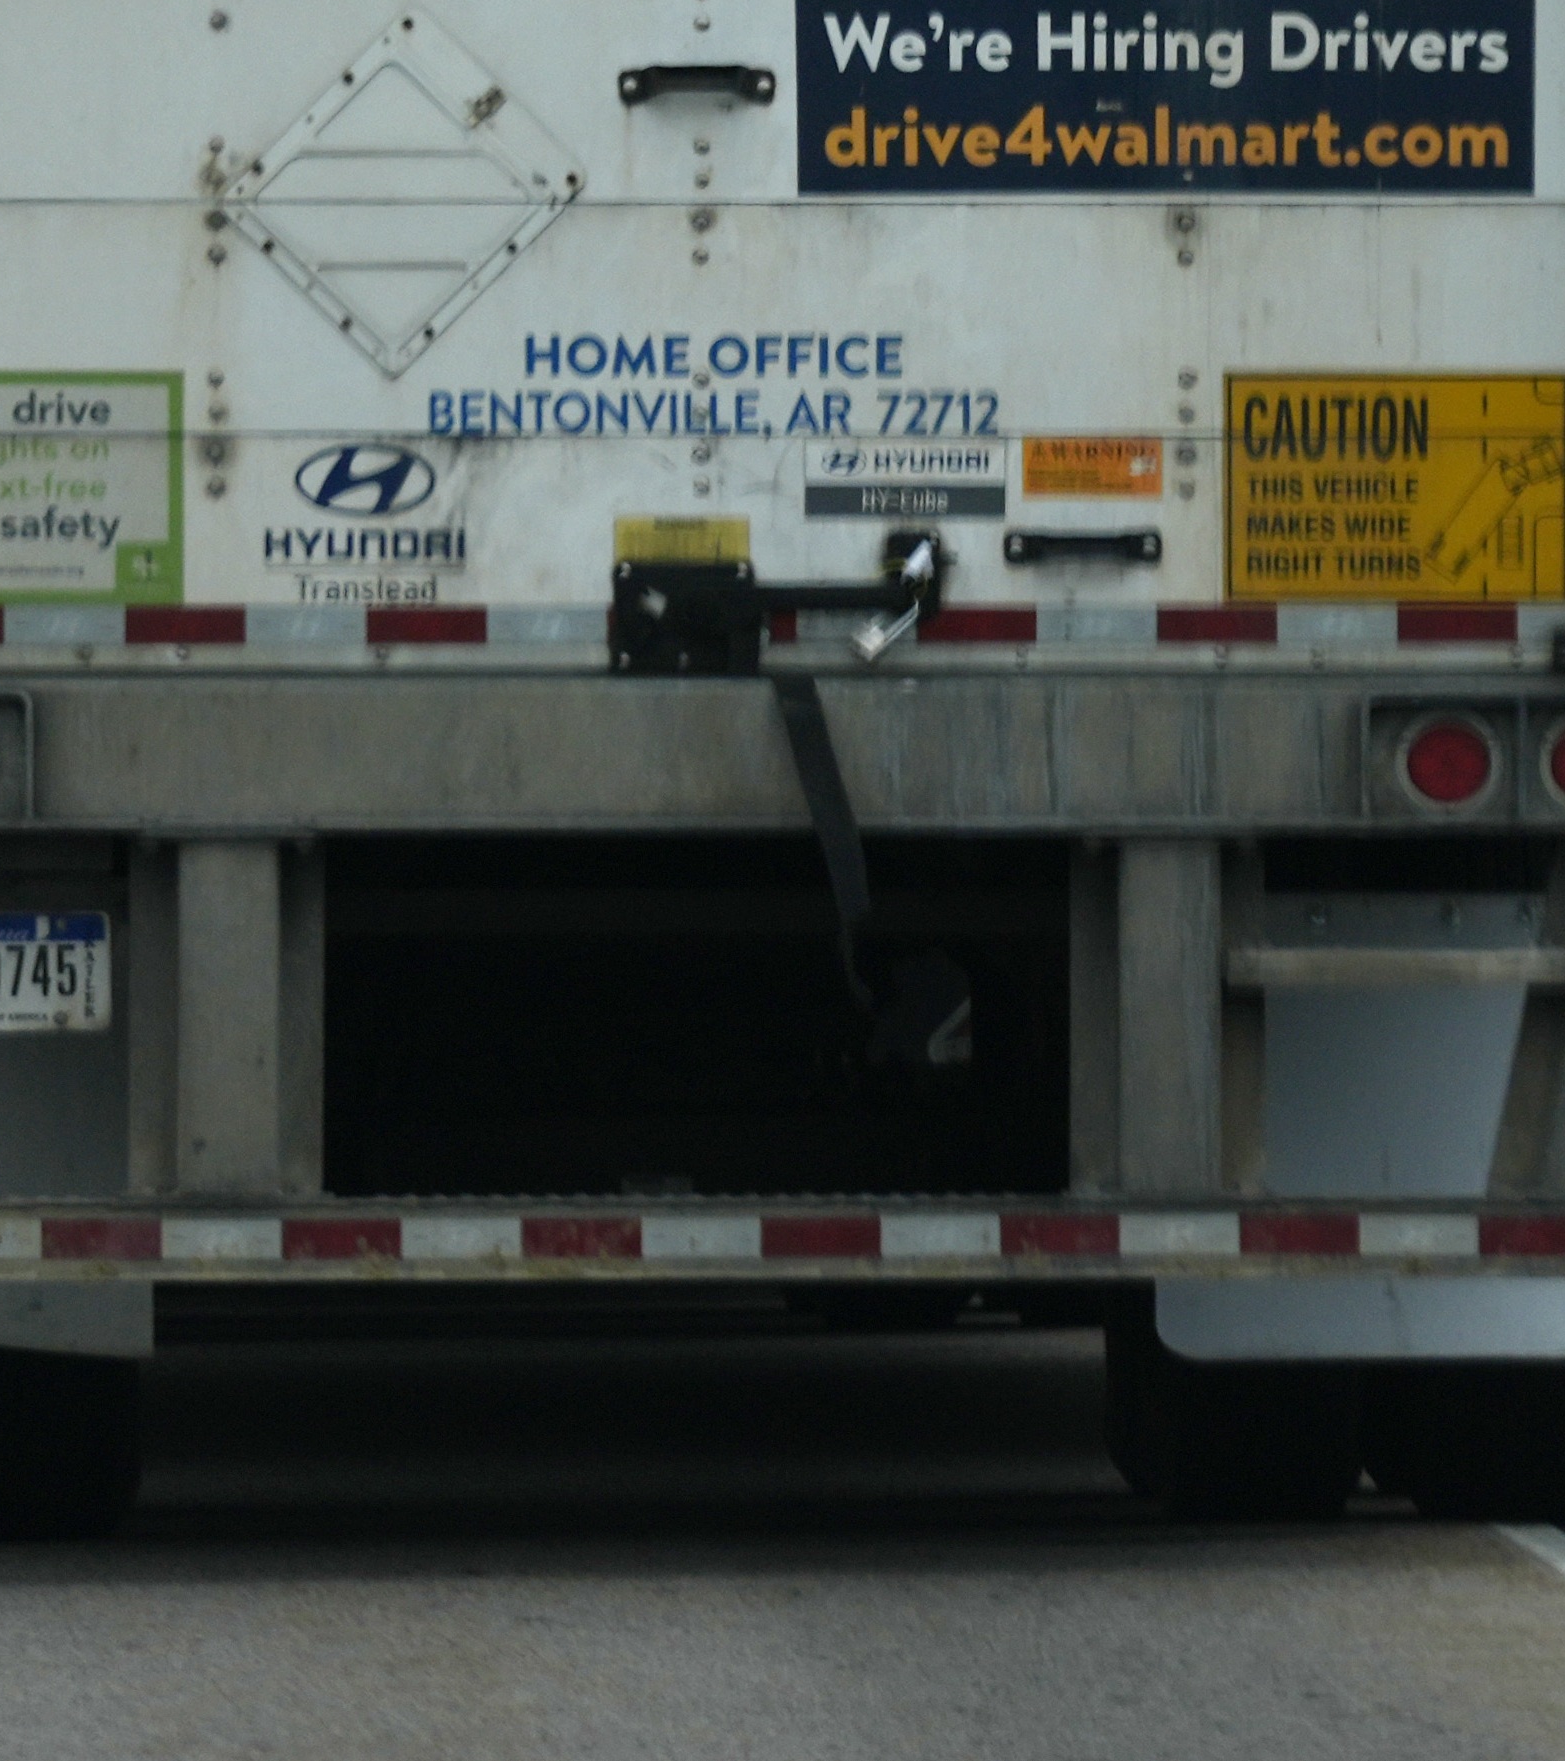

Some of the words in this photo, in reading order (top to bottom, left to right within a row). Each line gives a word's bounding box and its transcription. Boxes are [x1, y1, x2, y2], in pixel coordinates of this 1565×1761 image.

[823, 12, 1012, 74] We're
[1037, 12, 1245, 88] Hiring
[1269, 12, 1510, 74] Drivers
[824, 105, 1510, 170] drive4walmart.com
[524, 333, 691, 378] HOME
[708, 333, 903, 378] OFFICE
[12, 390, 111, 425] drive
[428, 390, 772, 438] BENTONVILLE,
[789, 390, 850, 435] AR
[877, 392, 999, 436] 72712
[1243, 394, 1430, 462] CAUTION
[70, 438, 110, 461] on
[874, 447, 990, 474] HYUNDAI
[1247, 472, 1303, 504] THIS
[1314, 472, 1419, 504] VEHICLE
[0, 504, 121, 550] safety
[264, 527, 466, 560] HYUNDAI
[1246, 510, 1336, 543] MAKES
[1343, 510, 1411, 543] WIDE
[1246, 547, 1325, 581] RIGHT
[1335, 547, 1421, 581] TURNS
[294, 574, 437, 603] Translead
